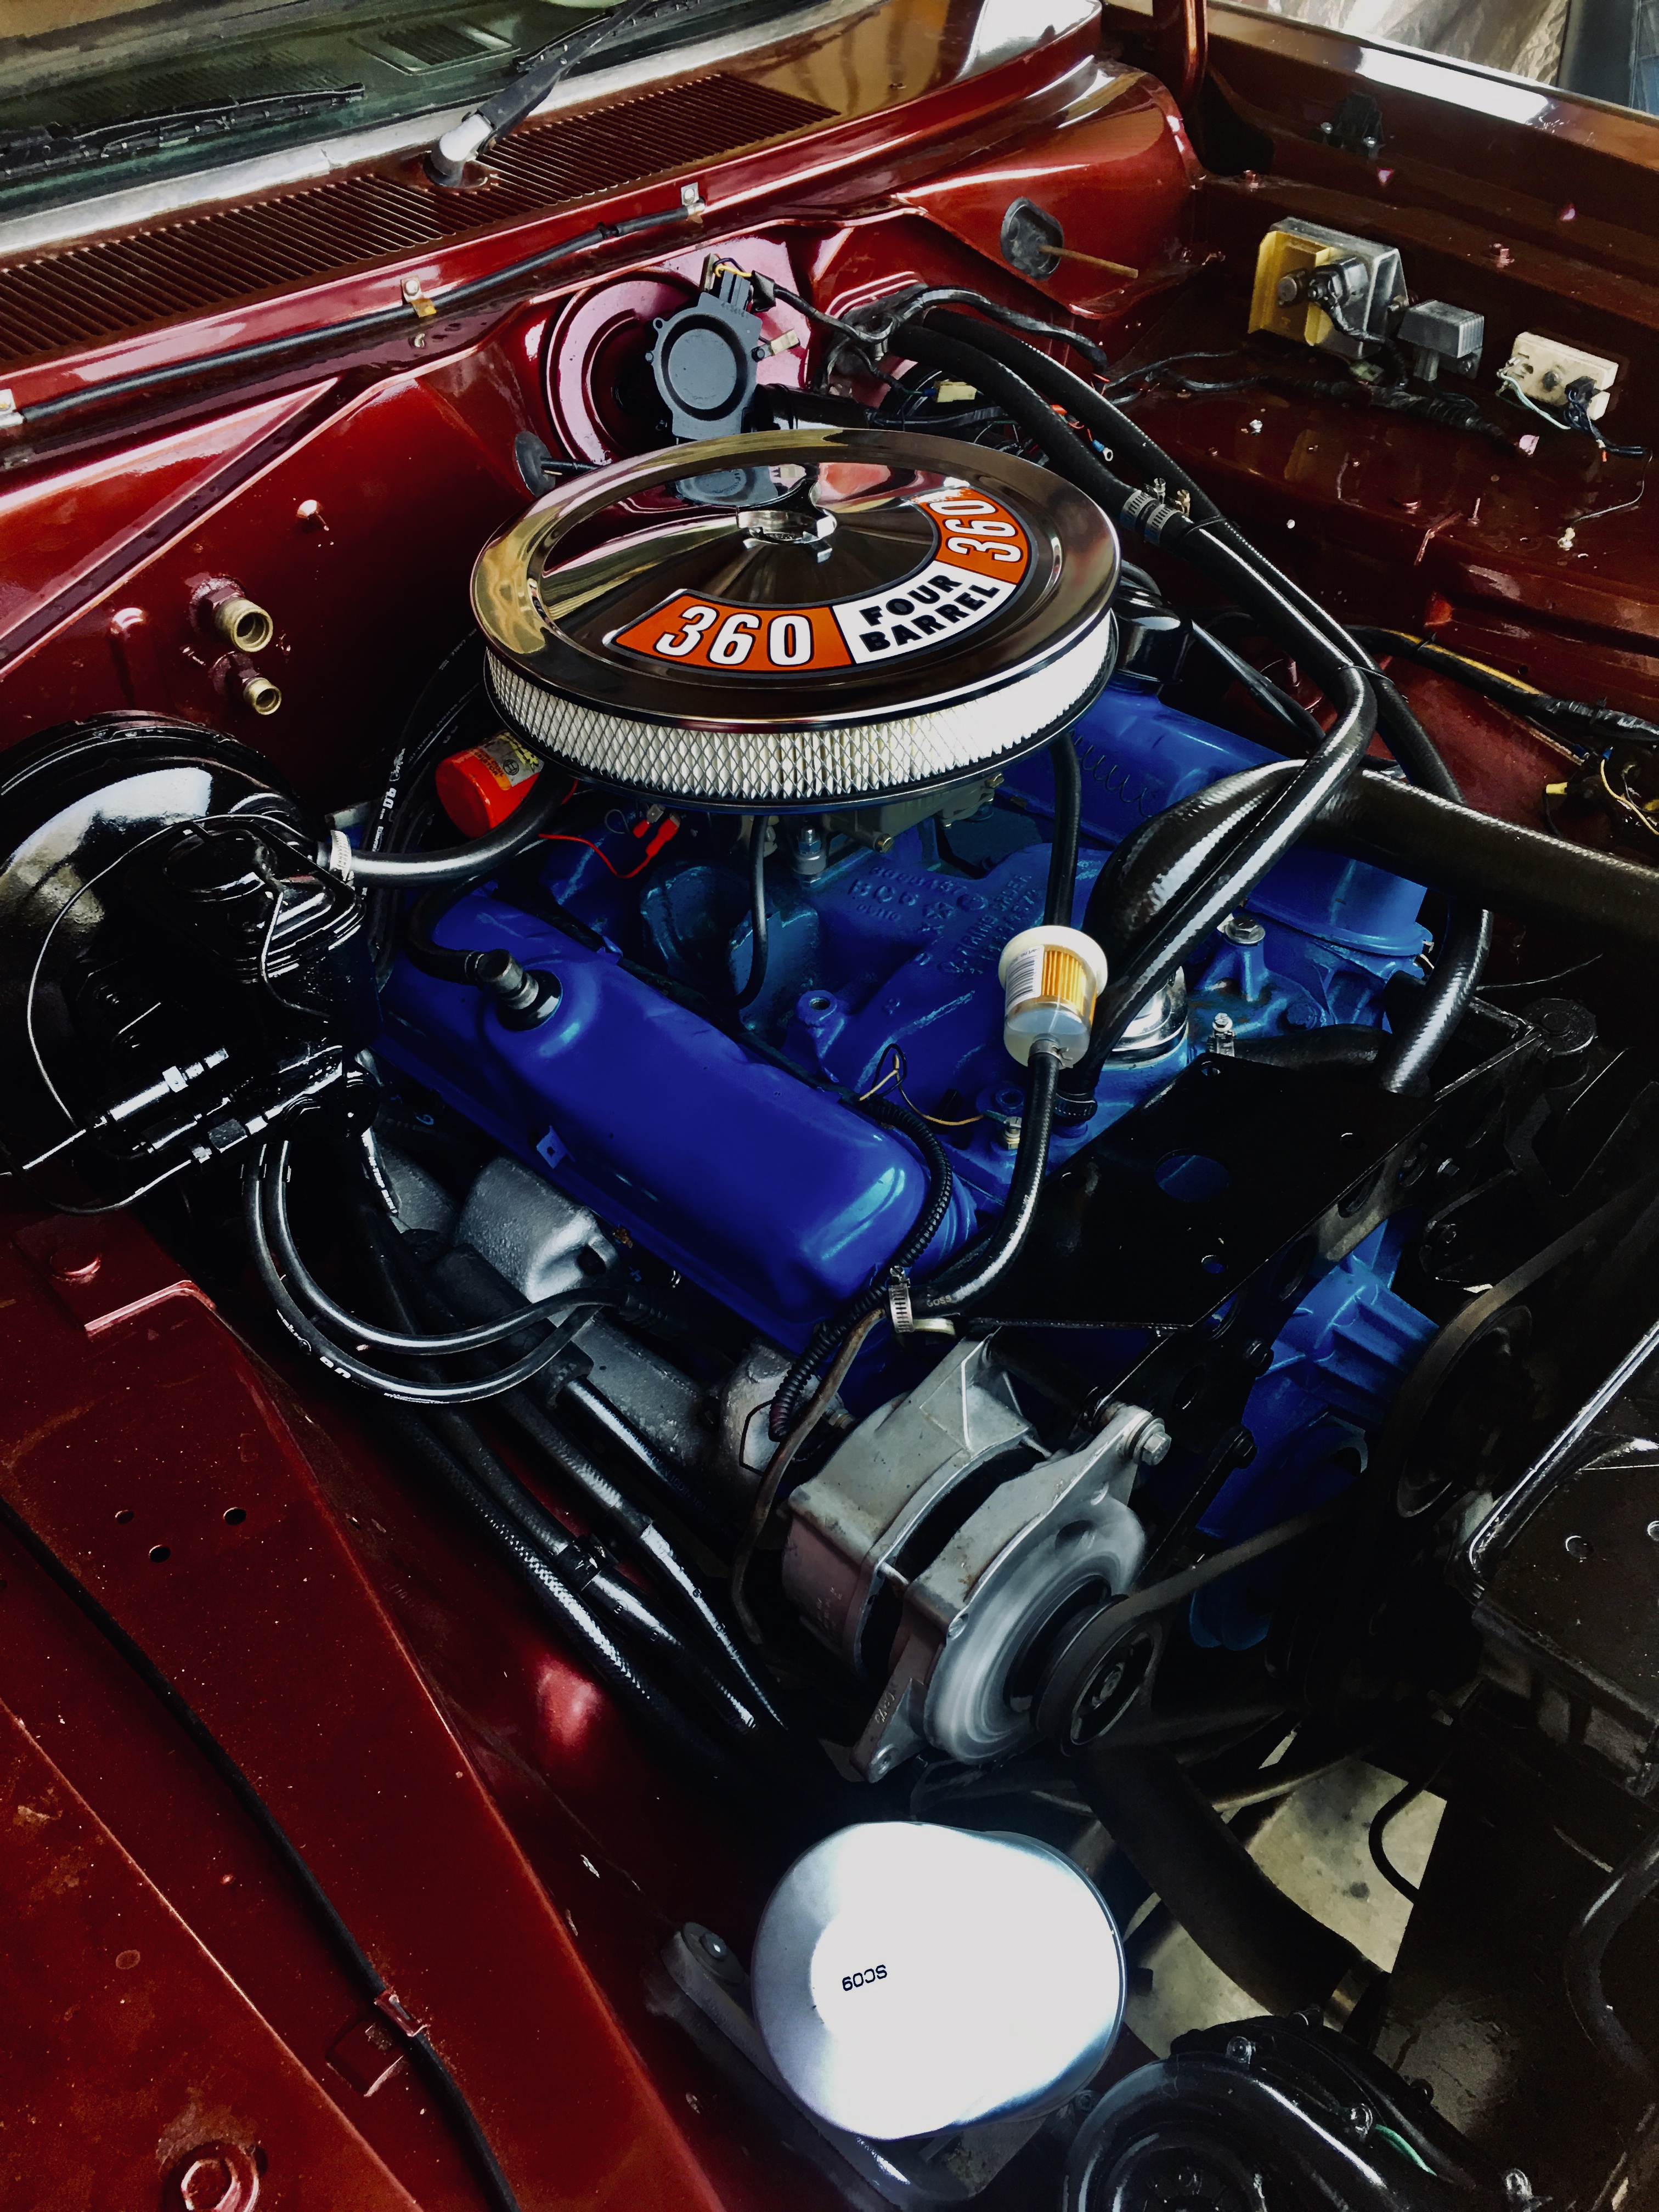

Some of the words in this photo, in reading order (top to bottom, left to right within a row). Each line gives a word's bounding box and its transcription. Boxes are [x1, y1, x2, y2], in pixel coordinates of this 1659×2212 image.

[927, 499, 1024, 563] 360
[860, 574, 963, 627] FOUR
[860, 584, 1000, 653] BARREL
[653, 605, 815, 666] 360
[842, 1964, 888, 1991] SC09
